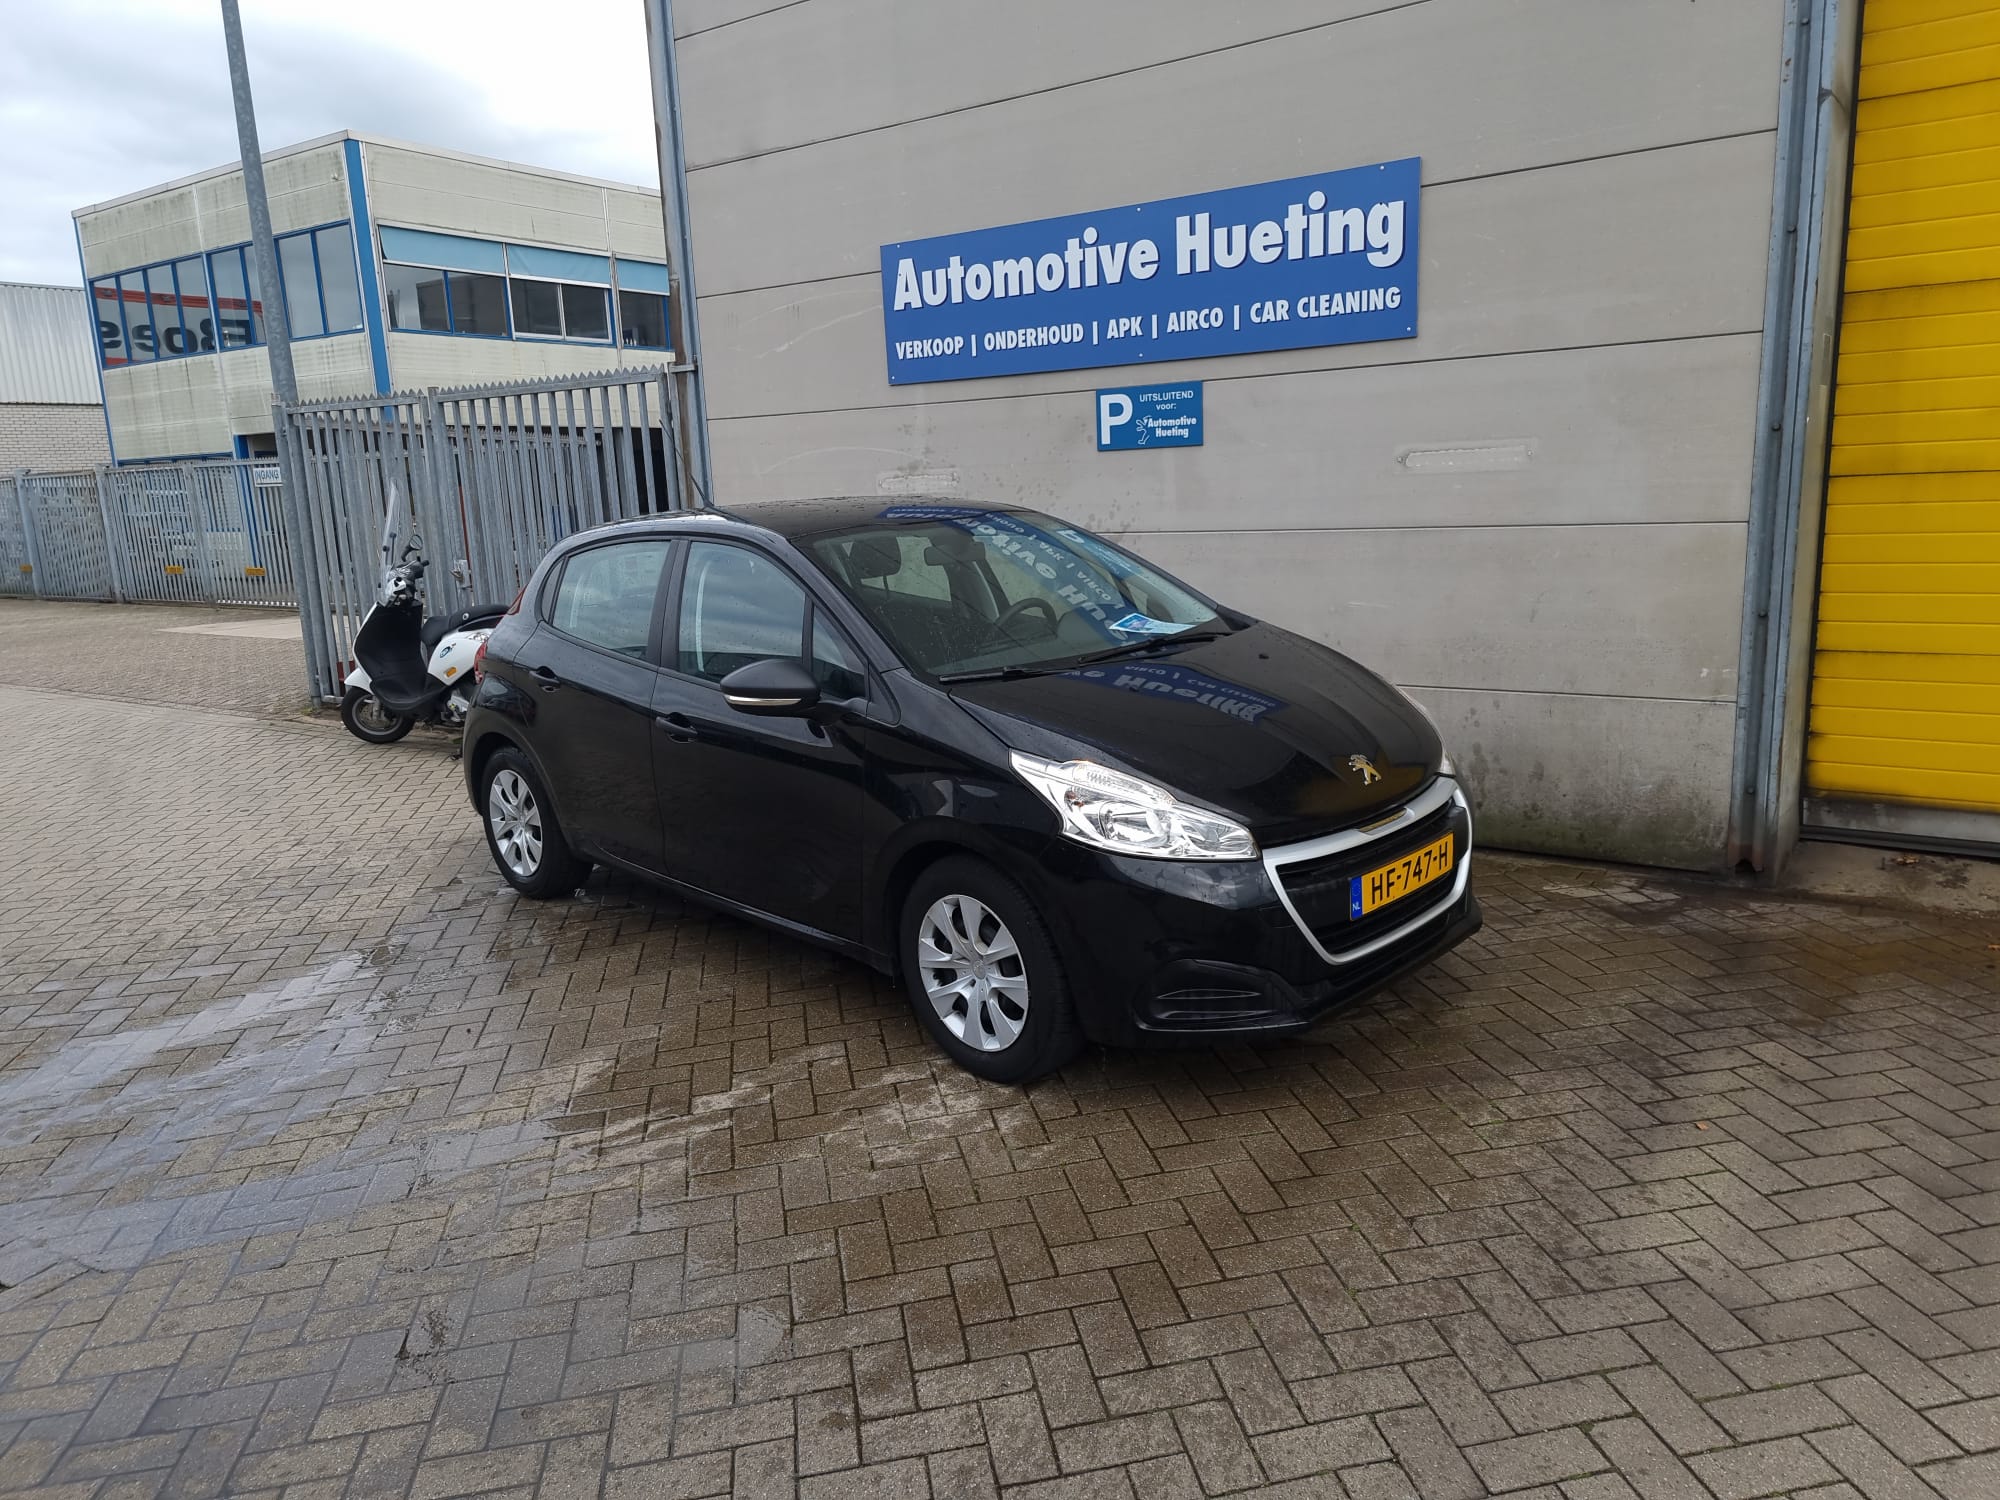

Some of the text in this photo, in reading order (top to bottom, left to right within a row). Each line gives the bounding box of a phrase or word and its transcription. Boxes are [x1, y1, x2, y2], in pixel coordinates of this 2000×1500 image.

[894, 190, 1404, 311] Automotive Hueting
[895, 286, 1401, 360] VERKOOP ONDERHOUD APK AIRCO CAR CLEANING
[1100, 394, 1133, 445] P
[1139, 390, 1194, 403] UITSLUITEND
[1147, 415, 1197, 428] Automotive
[1155, 426, 1189, 438] Hueting
[1371, 841, 1449, 904] HF-747-H
